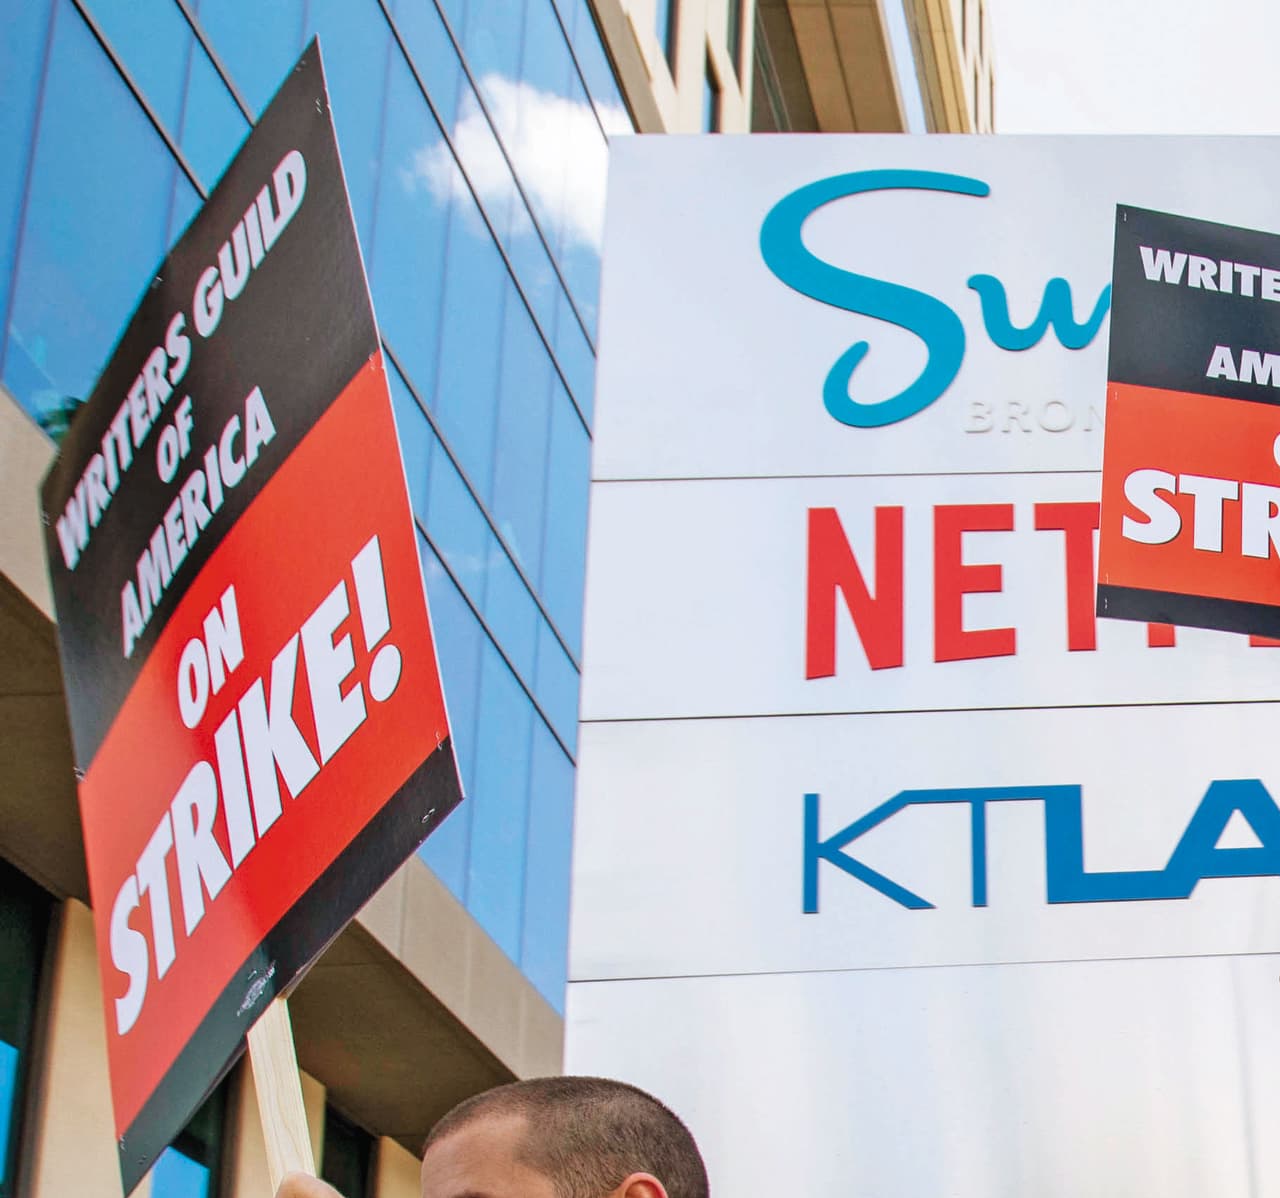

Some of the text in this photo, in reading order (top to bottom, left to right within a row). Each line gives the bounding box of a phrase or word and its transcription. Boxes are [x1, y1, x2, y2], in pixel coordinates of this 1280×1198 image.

[56, 150, 307, 570] WRITERS GUILD
[156, 396, 195, 484] OF
[119, 385, 277, 659] AMERICA
[177, 585, 244, 729] ON
[109, 534, 402, 1036] STRIKE!
